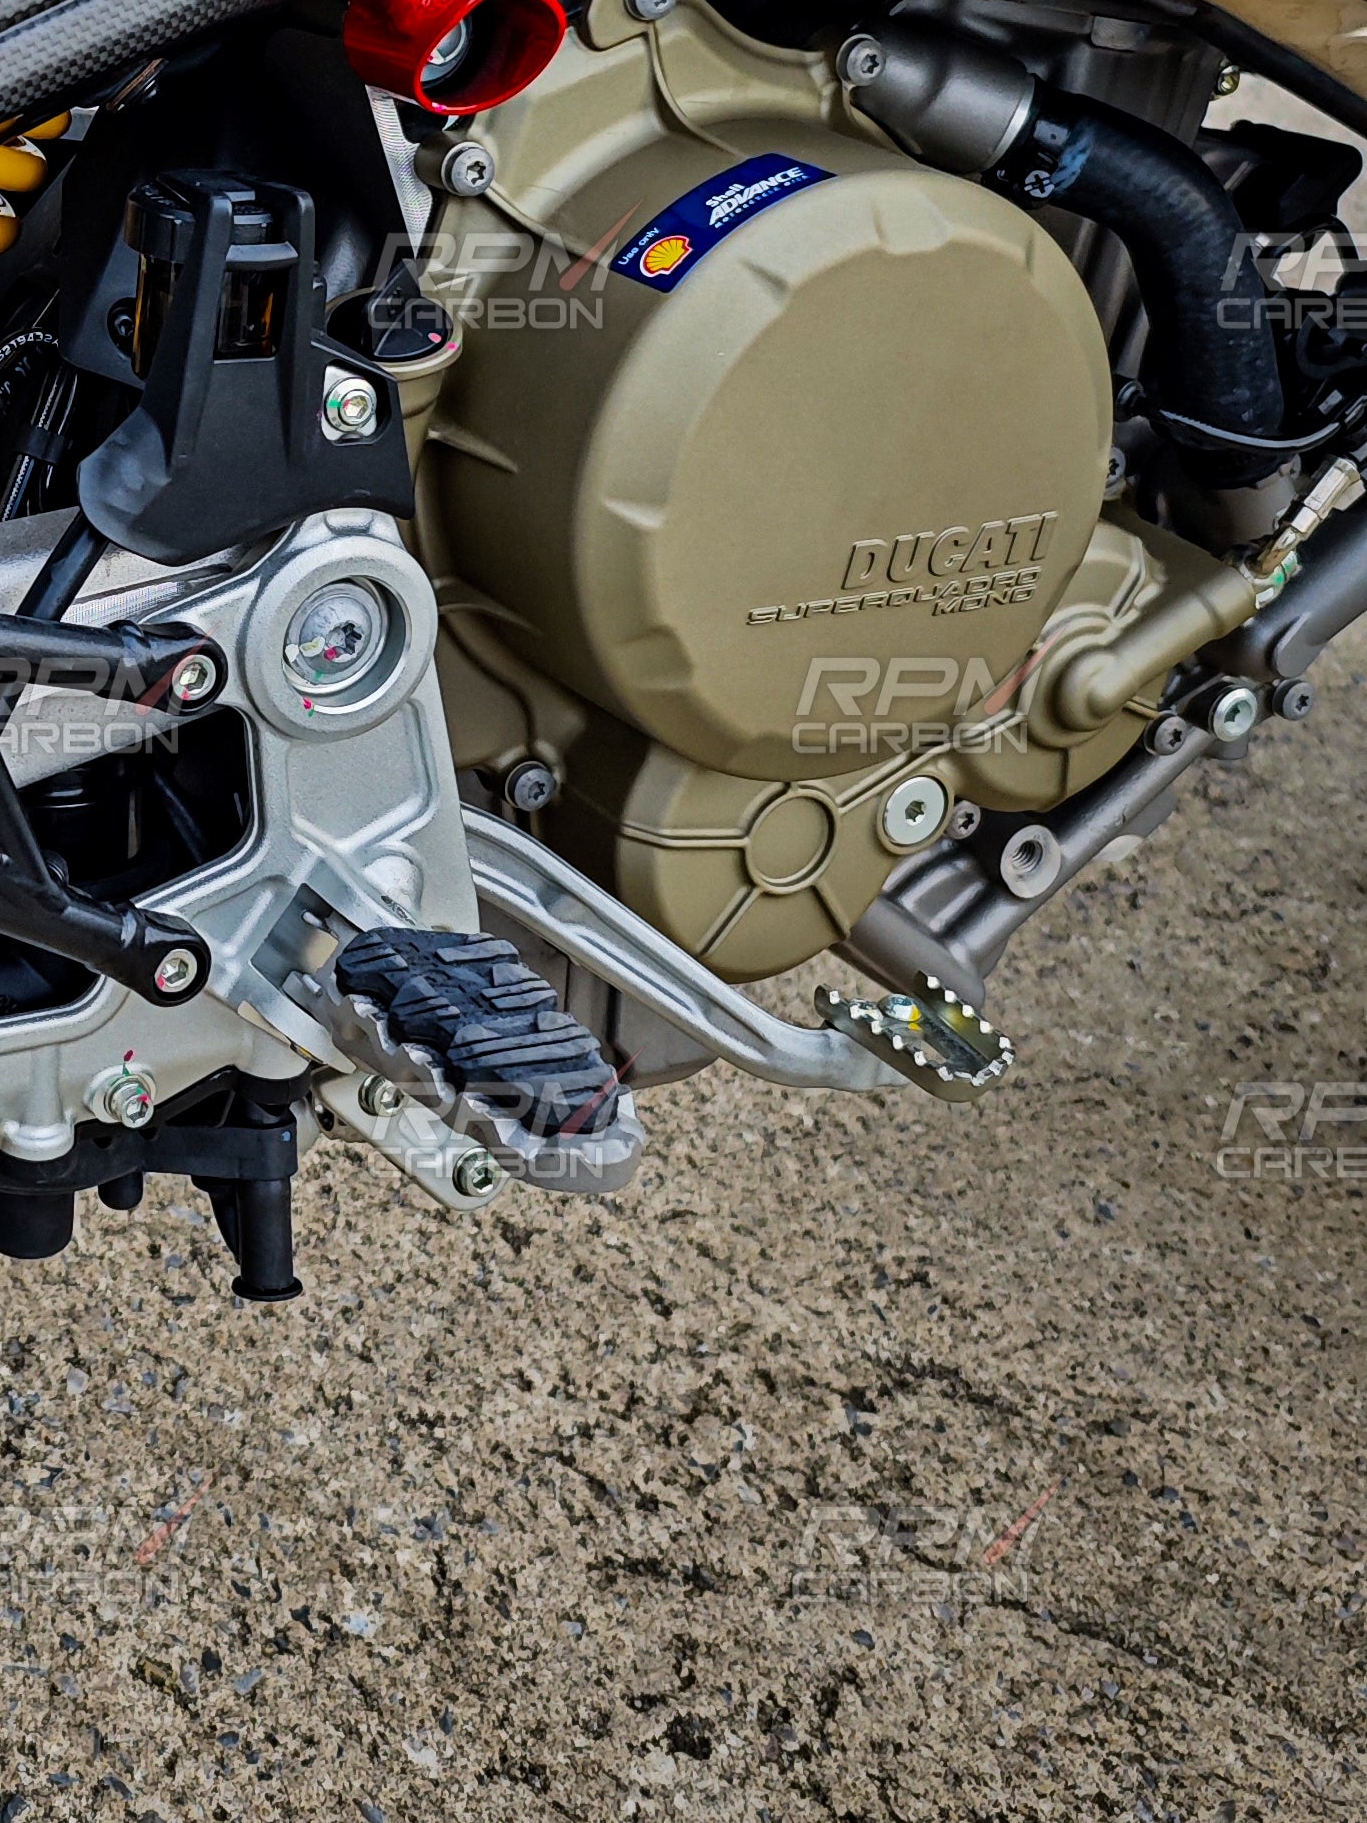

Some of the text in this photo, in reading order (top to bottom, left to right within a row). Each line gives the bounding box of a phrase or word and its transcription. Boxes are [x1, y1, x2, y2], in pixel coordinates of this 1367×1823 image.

[705, 183, 746, 208] Shell
[709, 166, 804, 226] ADVANCE
[618, 227, 660, 266] Use only
[840, 510, 1059, 591] DUCATI
[745, 565, 1042, 626] SUPERQUADRO
[931, 584, 1037, 617] MONO
